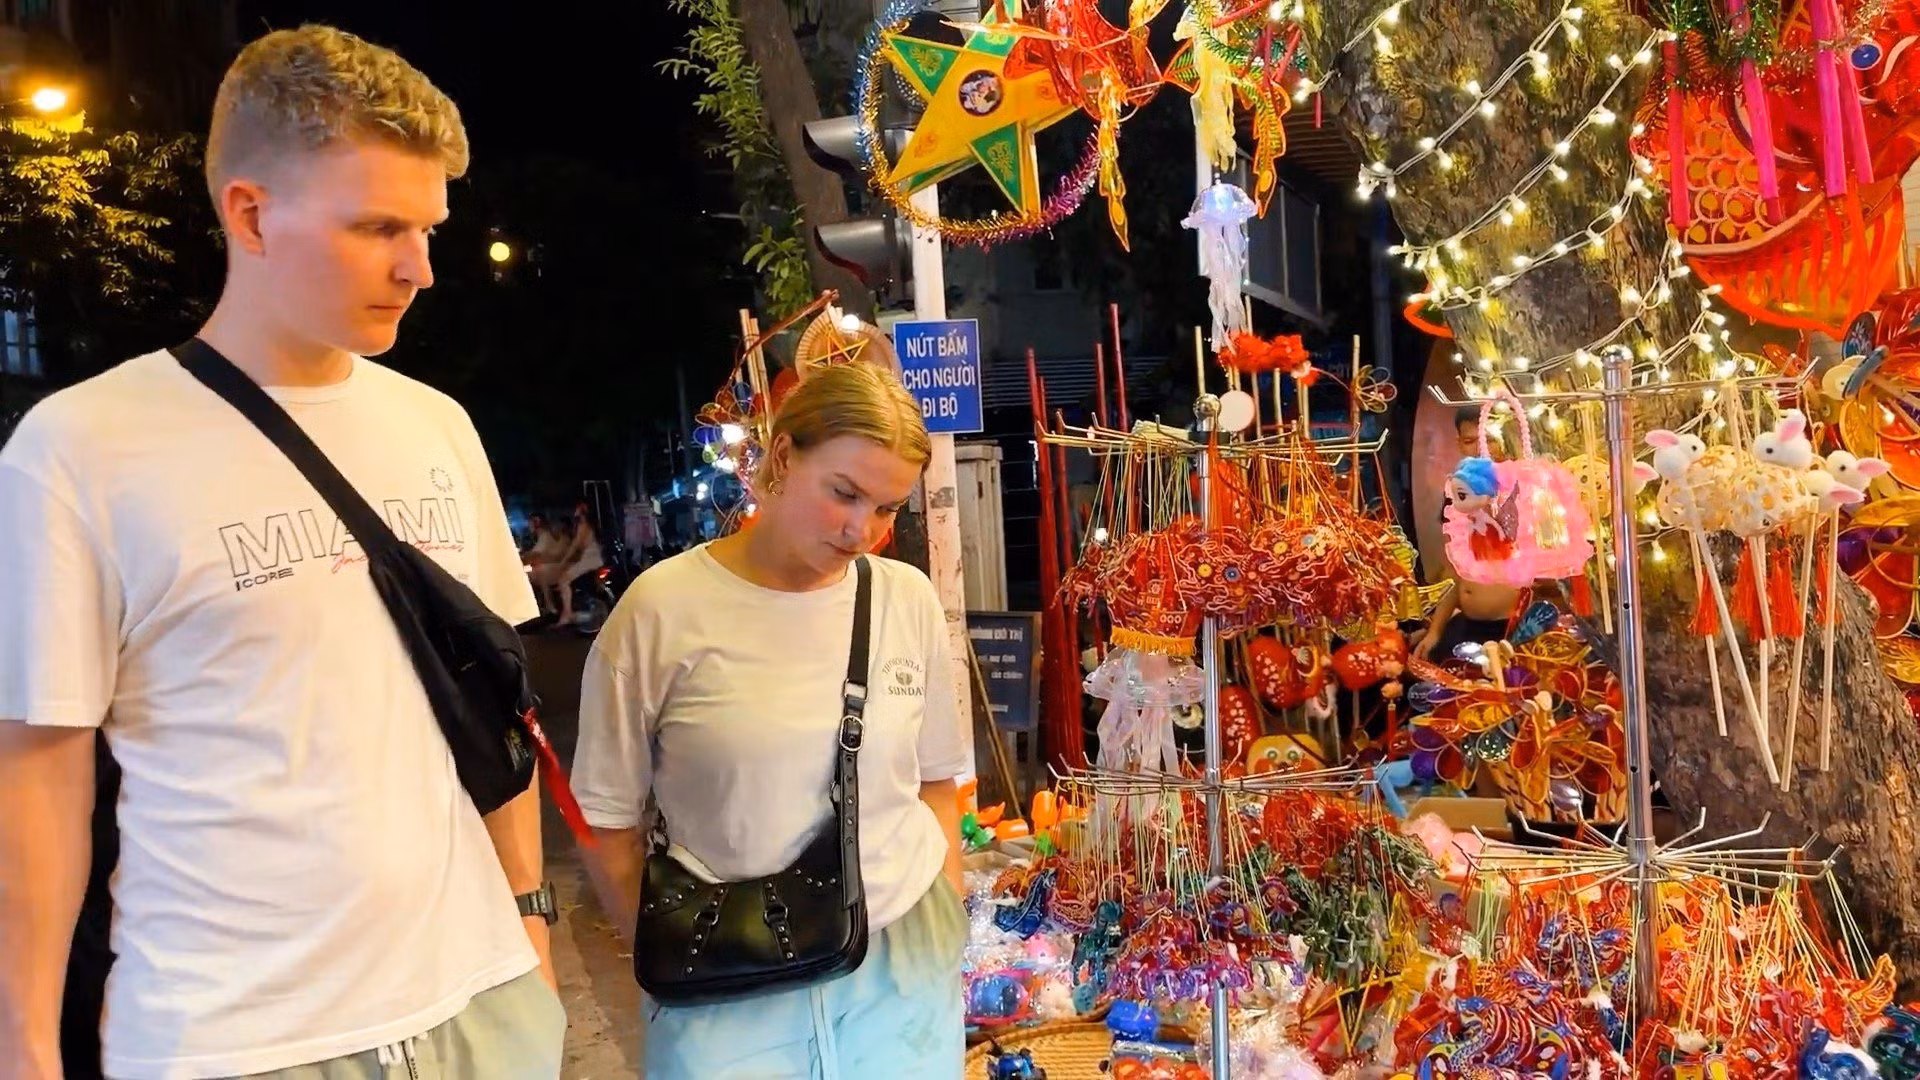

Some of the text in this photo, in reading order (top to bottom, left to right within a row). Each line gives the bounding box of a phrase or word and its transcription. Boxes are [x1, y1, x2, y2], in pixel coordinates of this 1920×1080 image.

[906, 328, 968, 358] NÚT BẤM
[903, 359, 976, 389] CHO NGƯỜI
[922, 392, 958, 420] ĐI BỘ
[235, 567, 295, 592] ICORE
